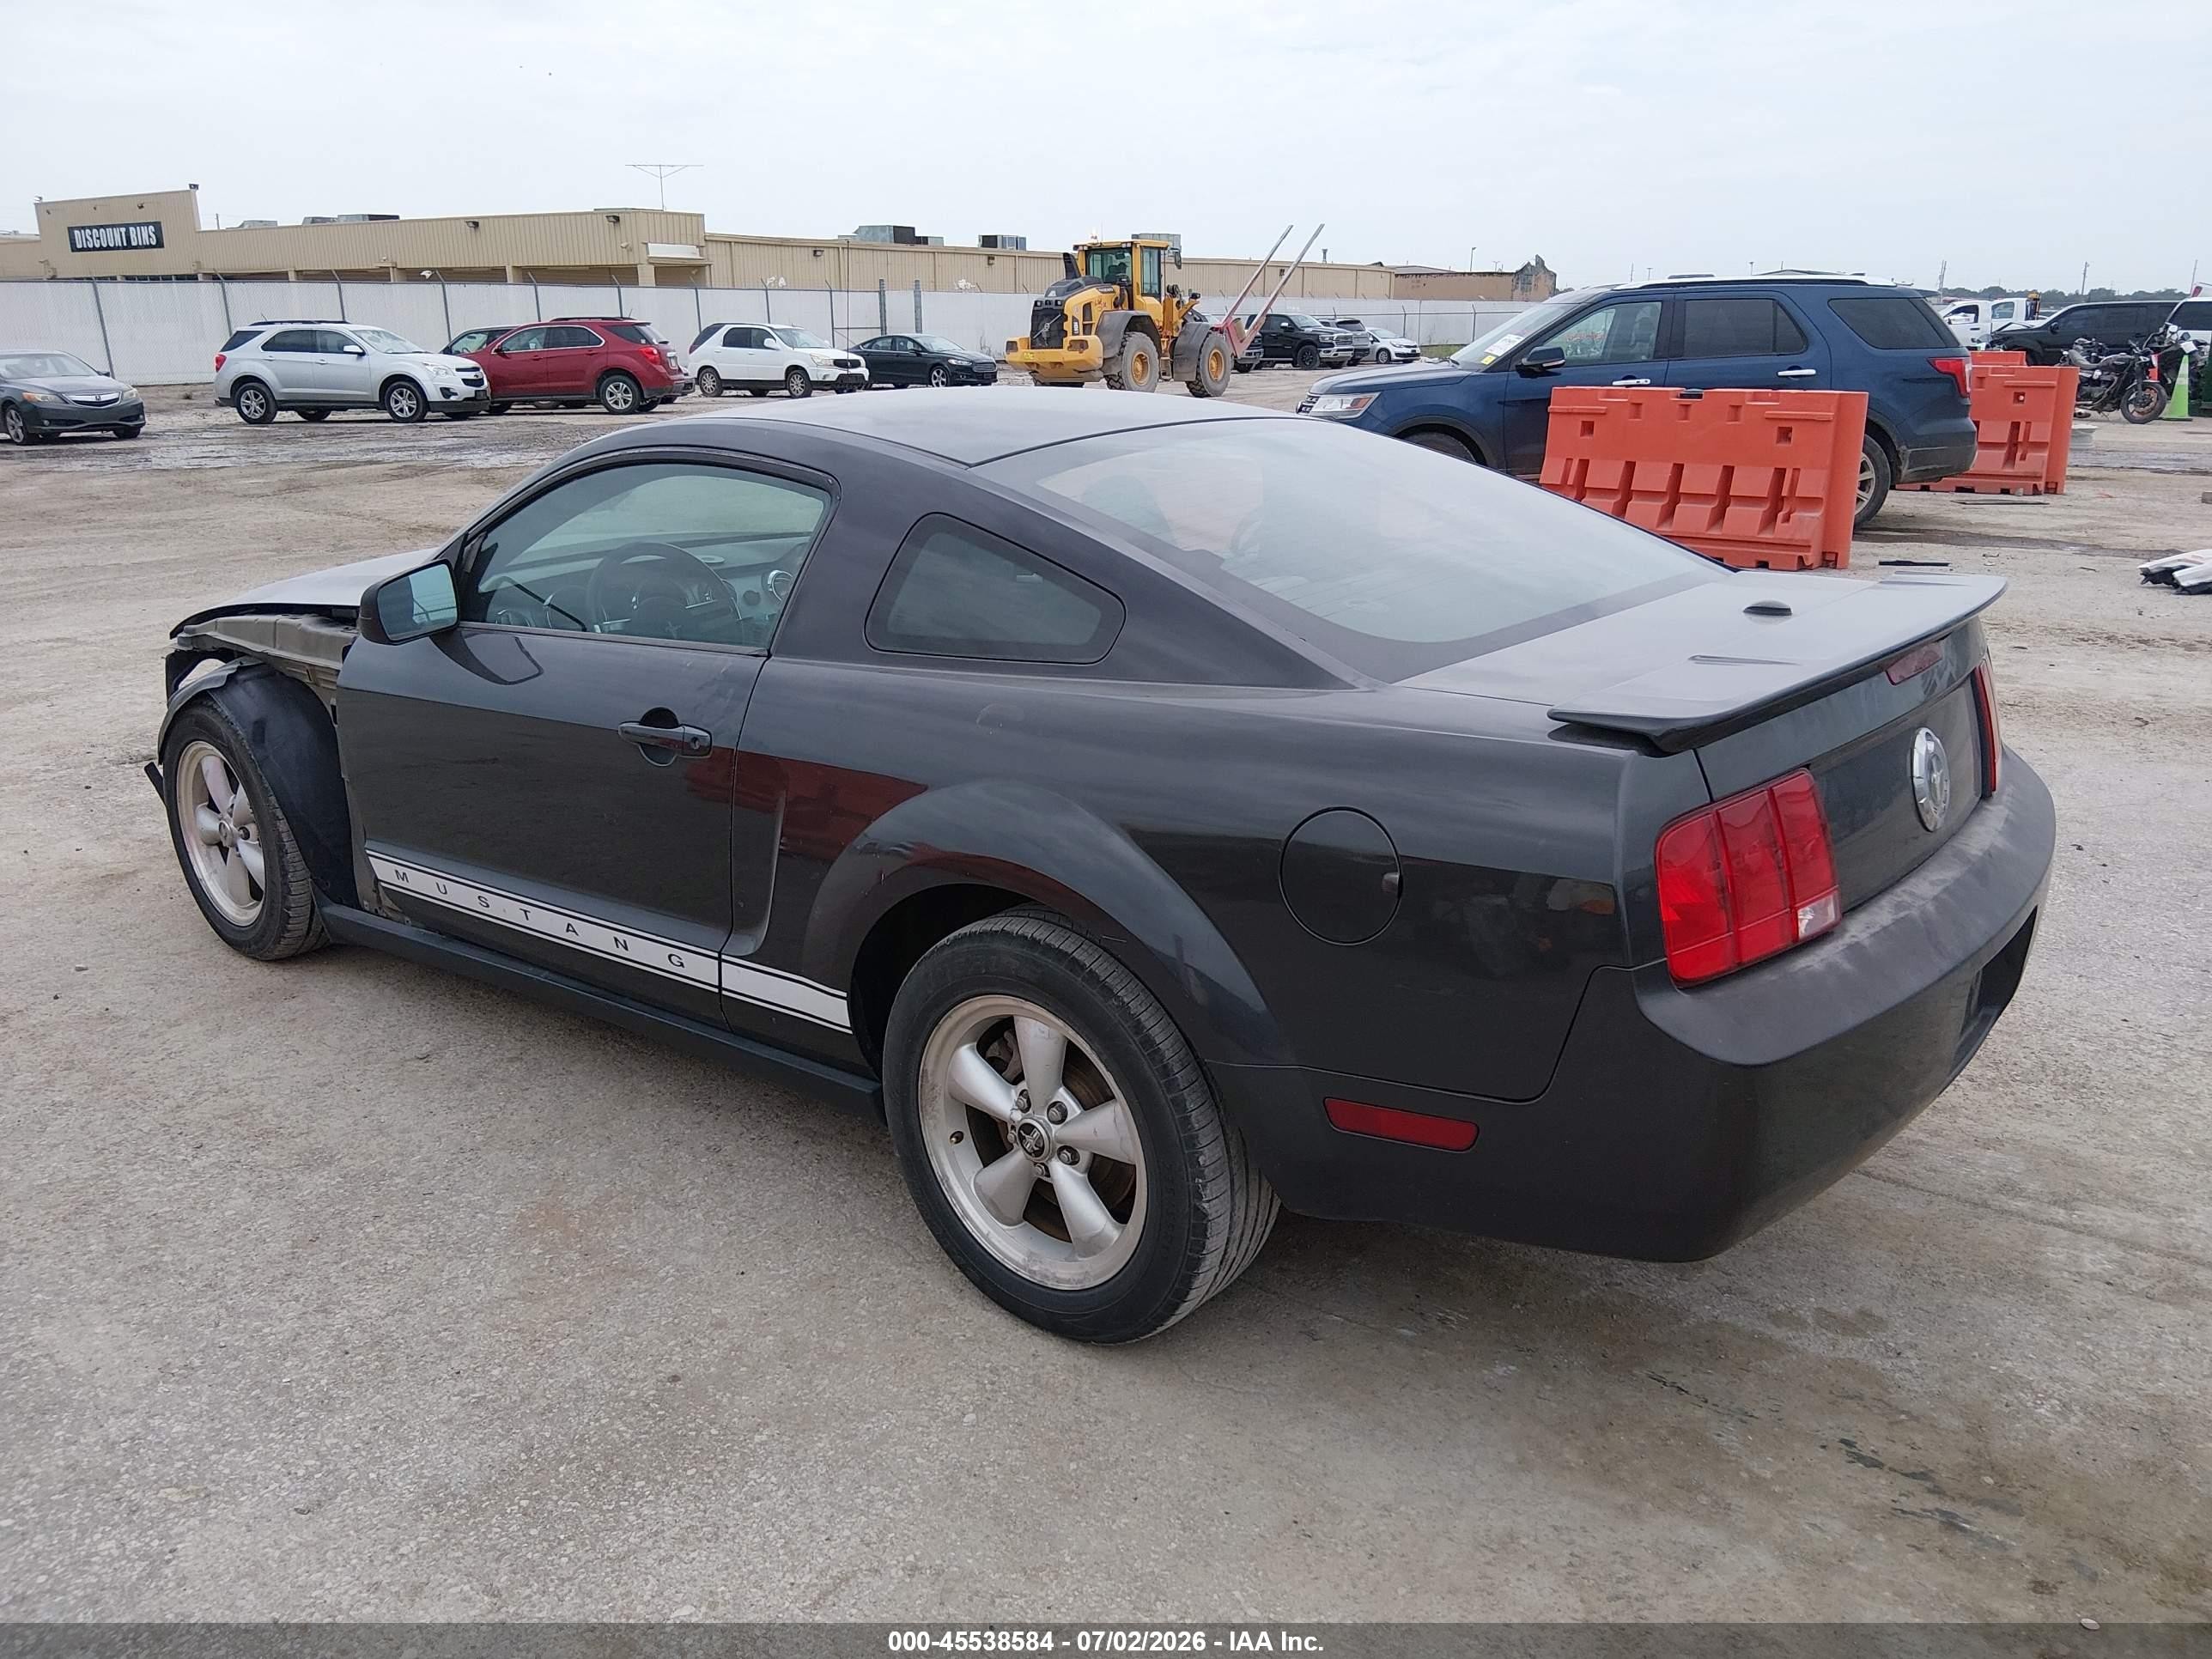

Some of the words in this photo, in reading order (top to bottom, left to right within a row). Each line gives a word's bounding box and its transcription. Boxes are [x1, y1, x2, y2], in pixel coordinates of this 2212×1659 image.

[74, 228, 127, 248] DISCOUNT
[129, 225, 157, 246] BINS
[395, 869, 685, 969] MUSTANG
